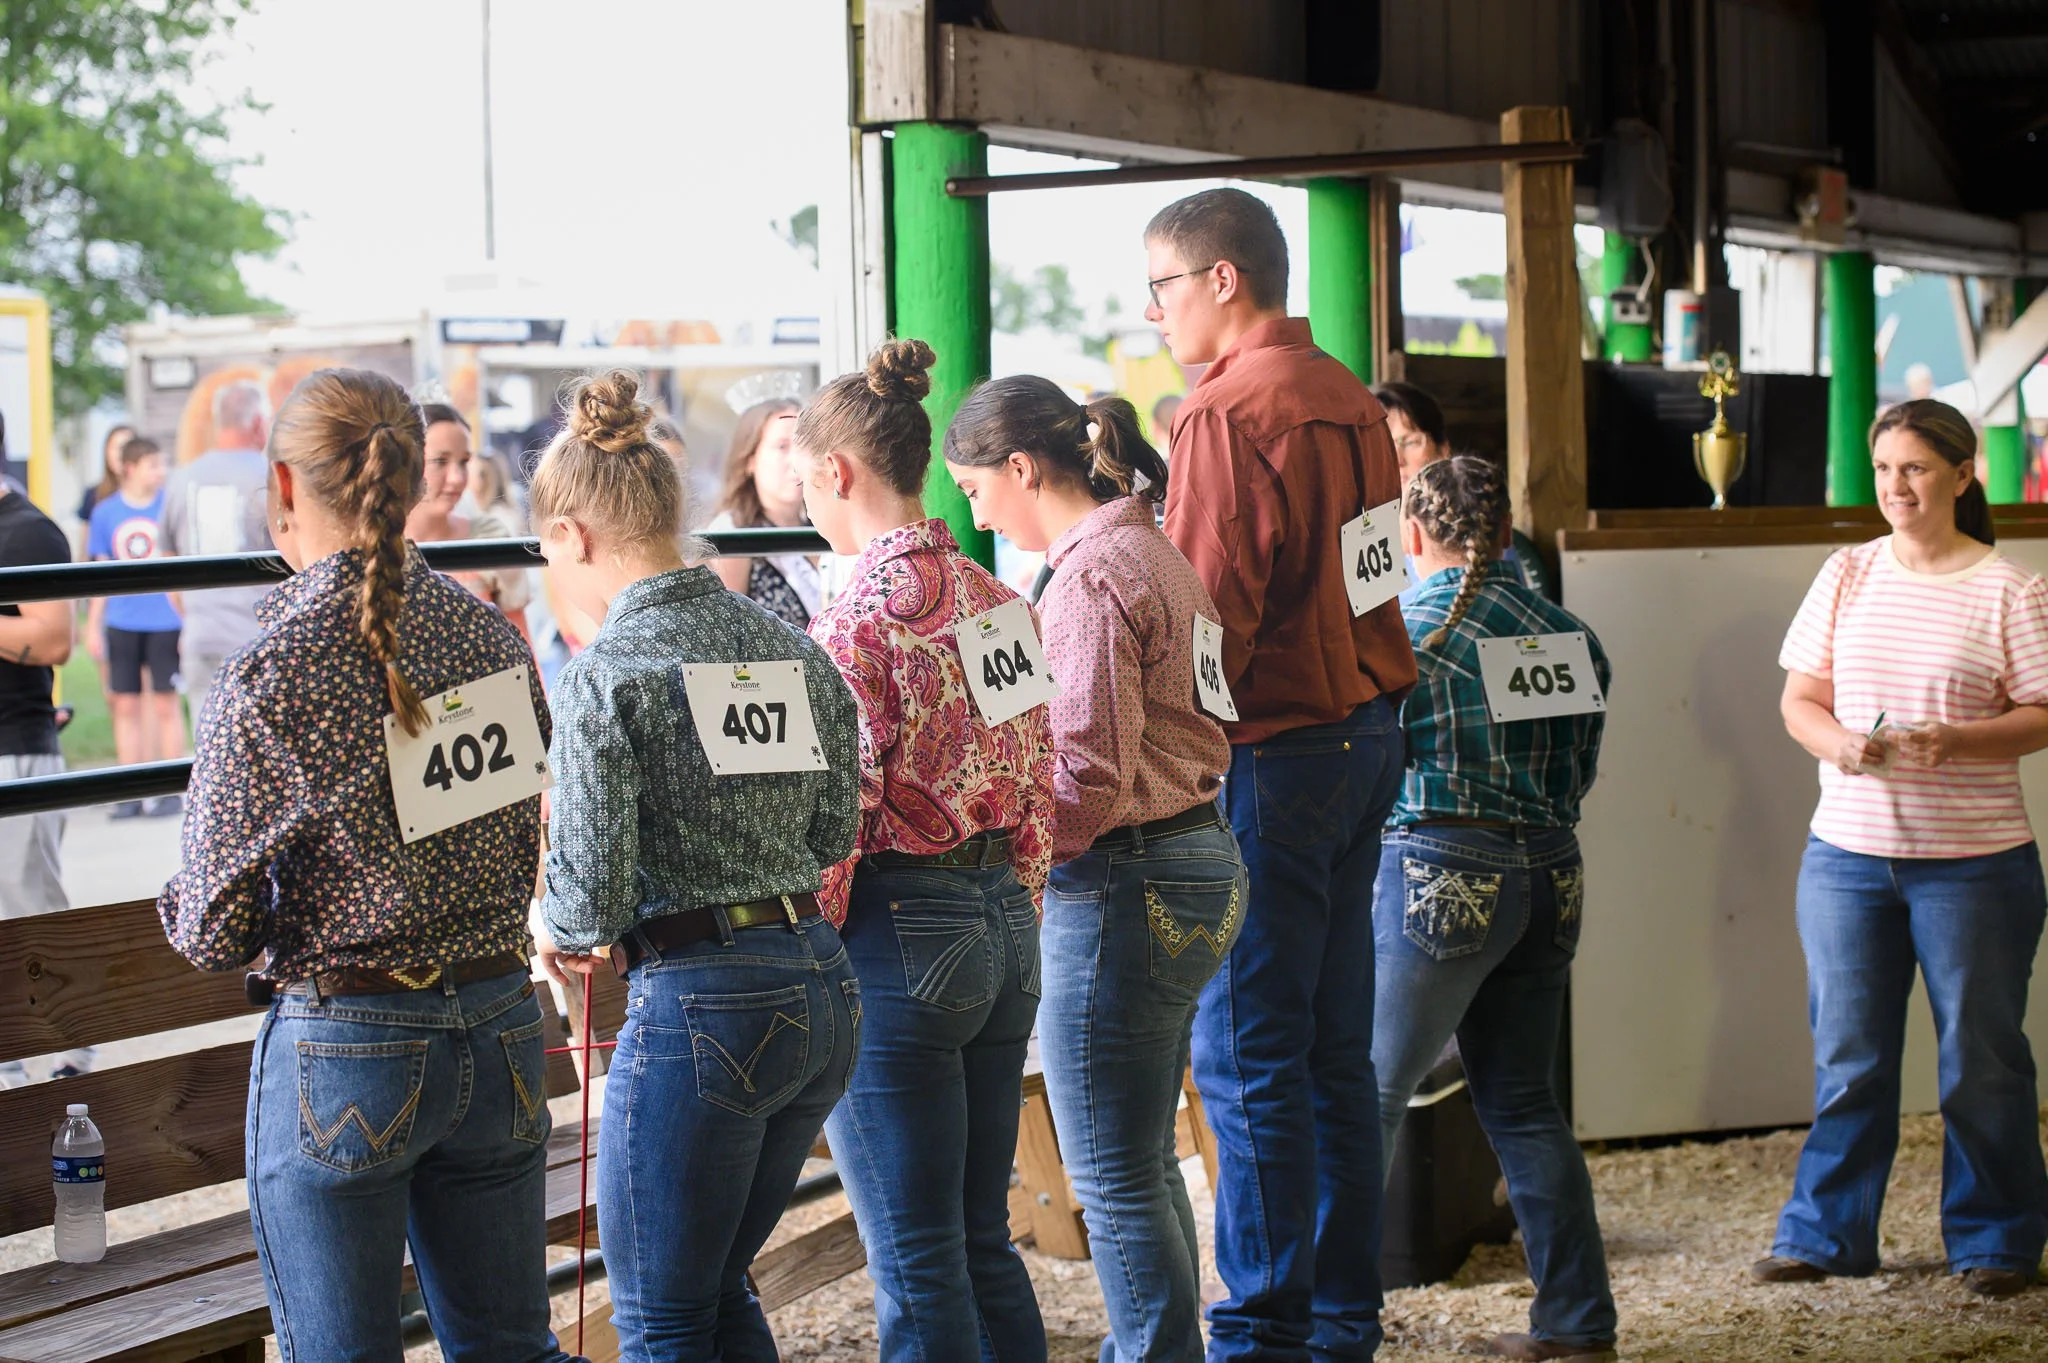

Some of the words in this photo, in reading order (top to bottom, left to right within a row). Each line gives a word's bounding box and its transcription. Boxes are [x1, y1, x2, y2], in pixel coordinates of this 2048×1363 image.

[1356, 536, 1393, 583] 403
[730, 681, 760, 692] Keystone
[982, 639, 1034, 692] 404
[1200, 651, 1220, 694] 406
[1508, 663, 1576, 697] 405
[438, 706, 474, 724] Keystone
[722, 702, 787, 744] 407
[423, 722, 515, 791] 402
